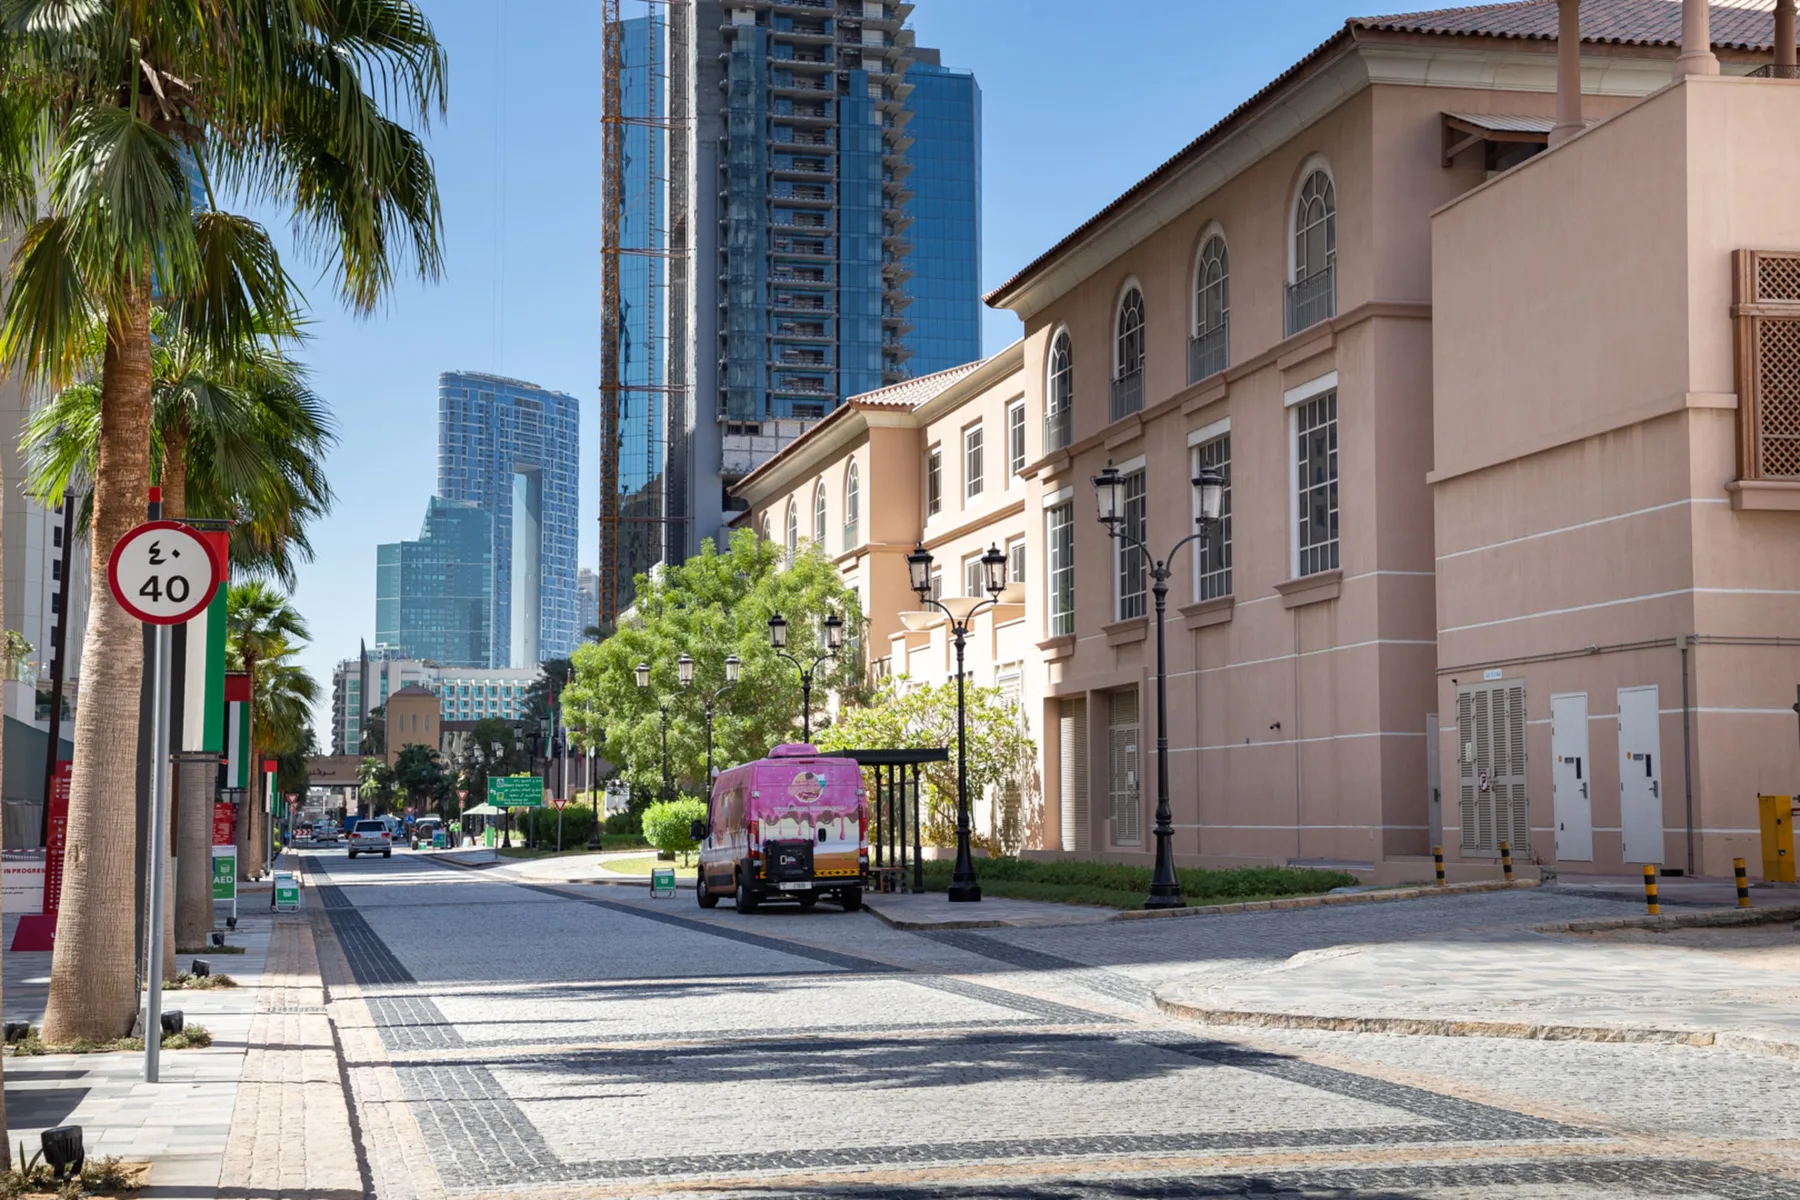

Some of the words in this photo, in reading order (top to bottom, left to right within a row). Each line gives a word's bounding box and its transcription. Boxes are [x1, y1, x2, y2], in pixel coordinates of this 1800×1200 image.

[148, 540, 181, 565] ٤٠
[139, 575, 190, 603] 40
[213, 876, 234, 884] AED
